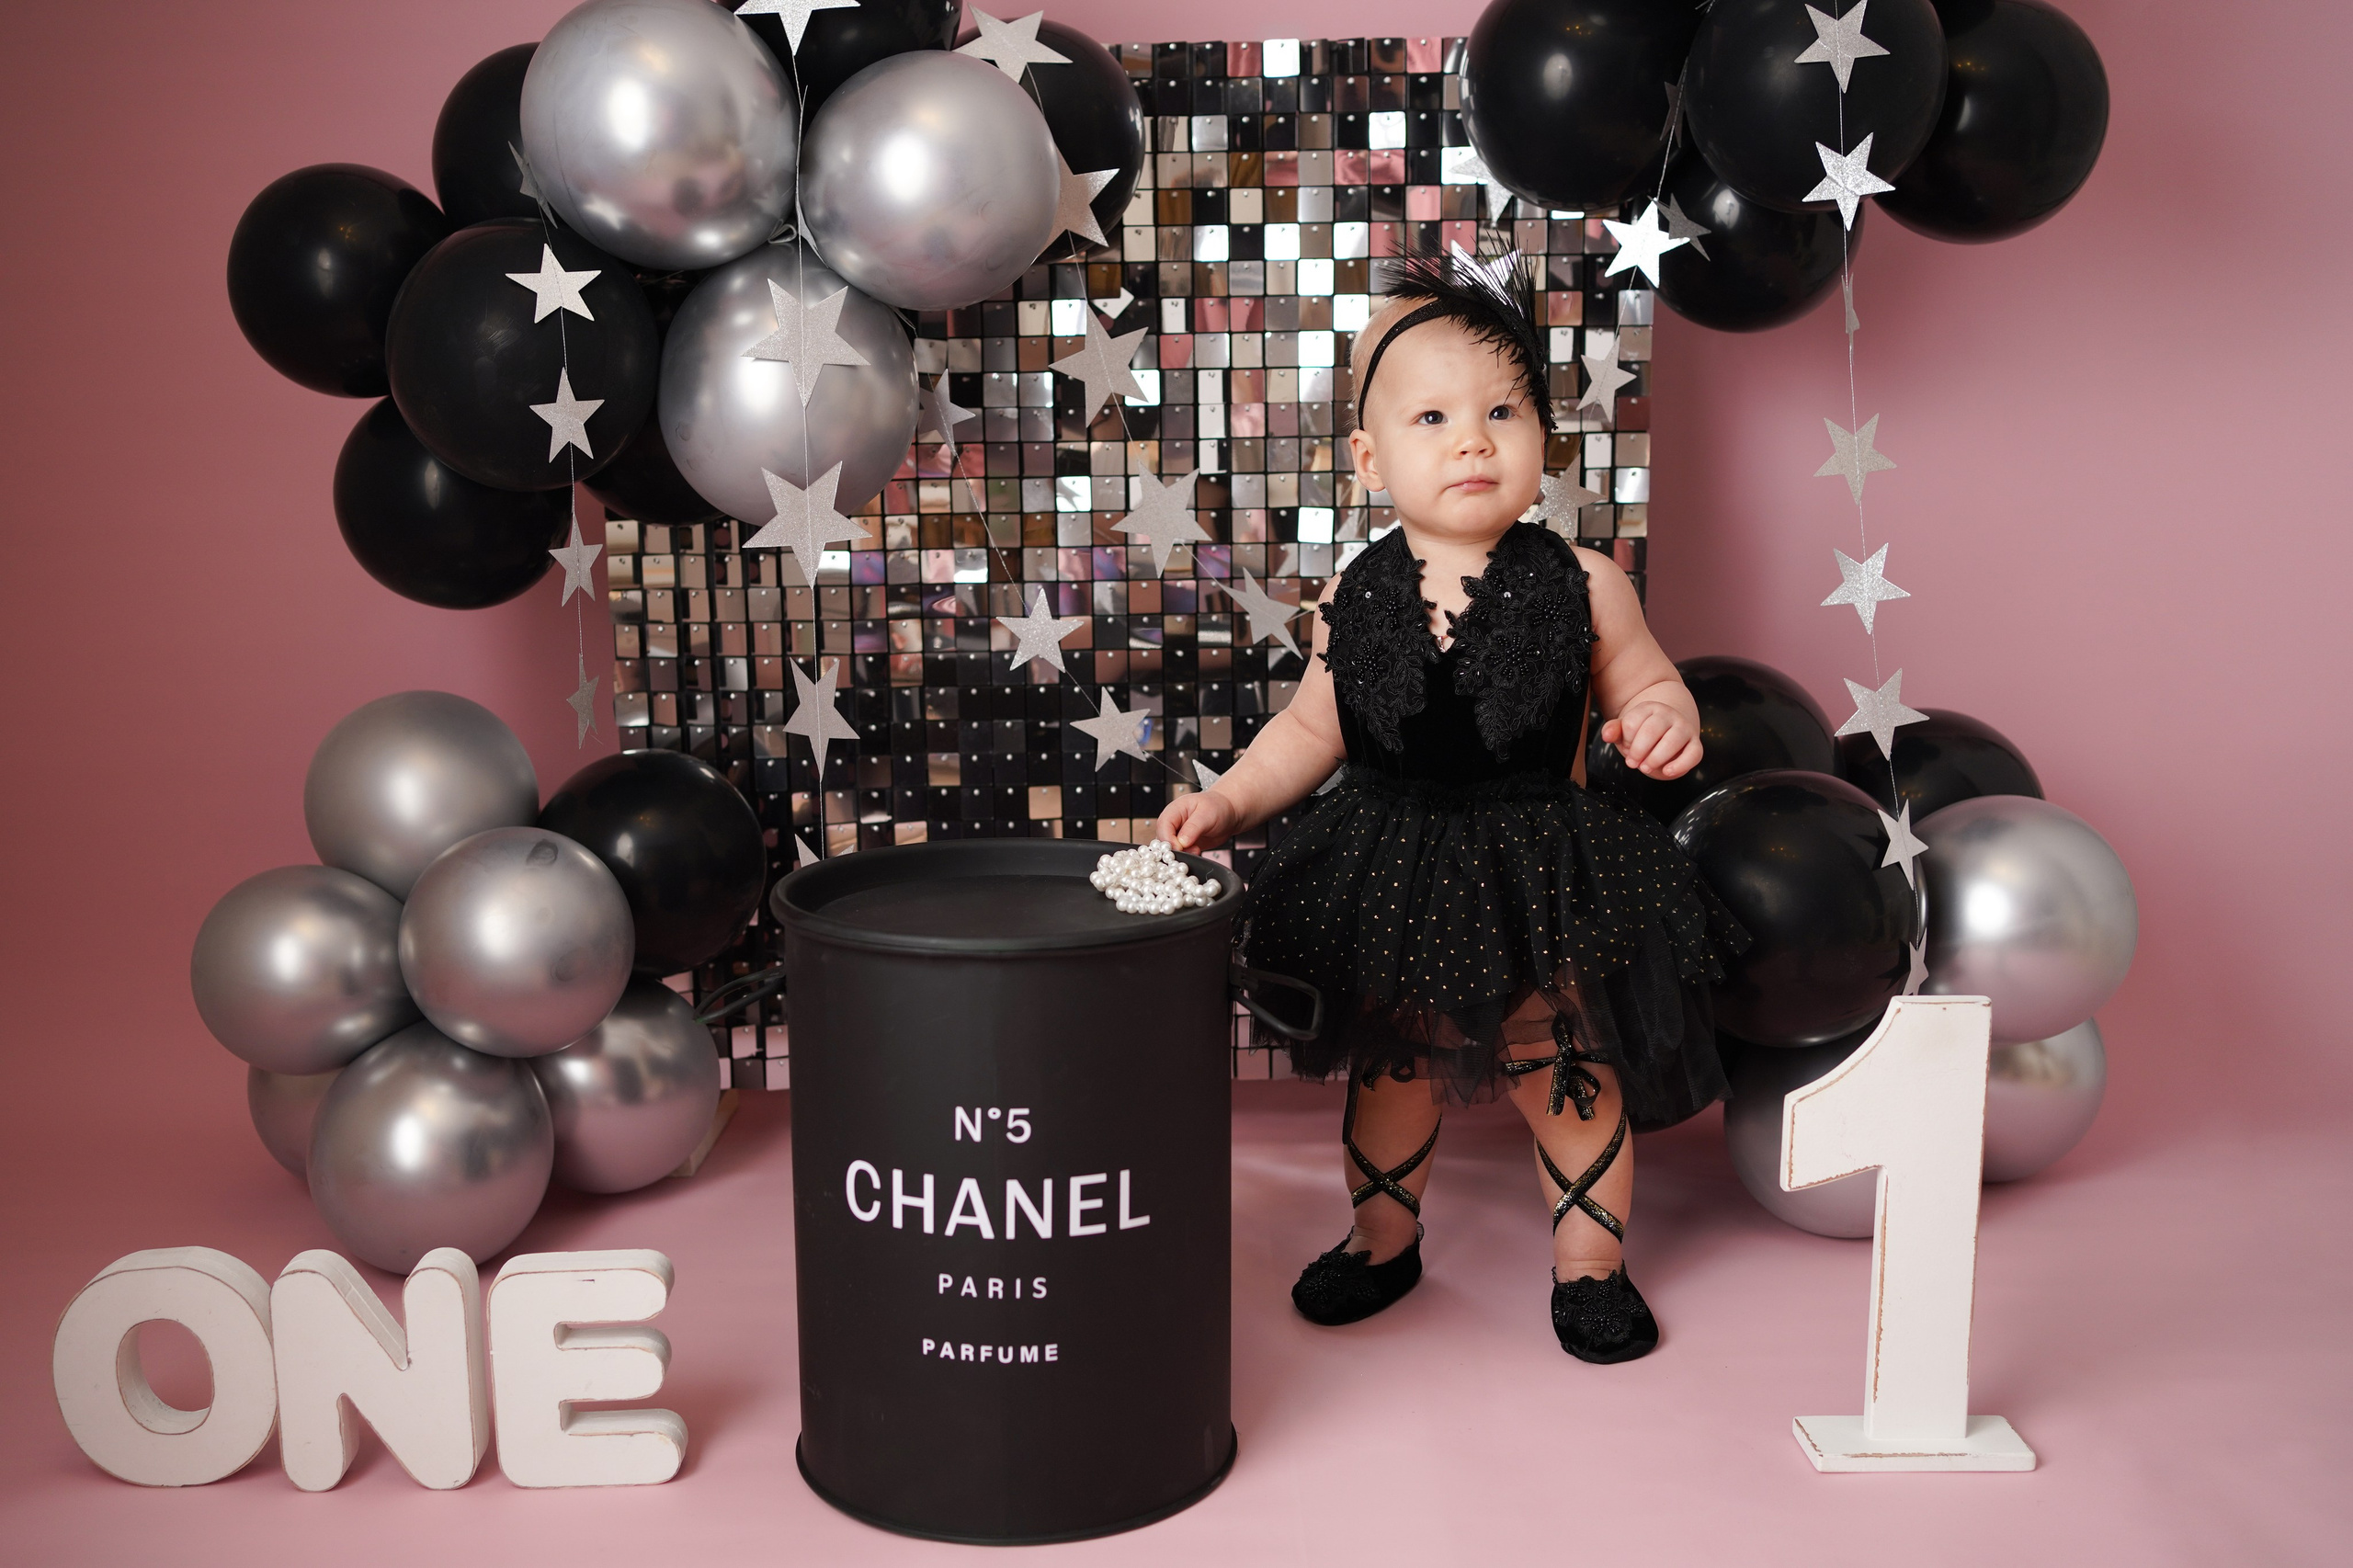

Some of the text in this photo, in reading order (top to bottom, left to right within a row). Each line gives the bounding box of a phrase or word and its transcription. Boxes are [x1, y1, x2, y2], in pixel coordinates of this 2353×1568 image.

[846, 1159, 1151, 1240] CHANEL
[1780, 995, 2036, 1472] 1
[938, 1273, 1047, 1300] PARIS
[53, 1246, 688, 1491] ONE
[922, 1338, 1059, 1364] PARFUME
